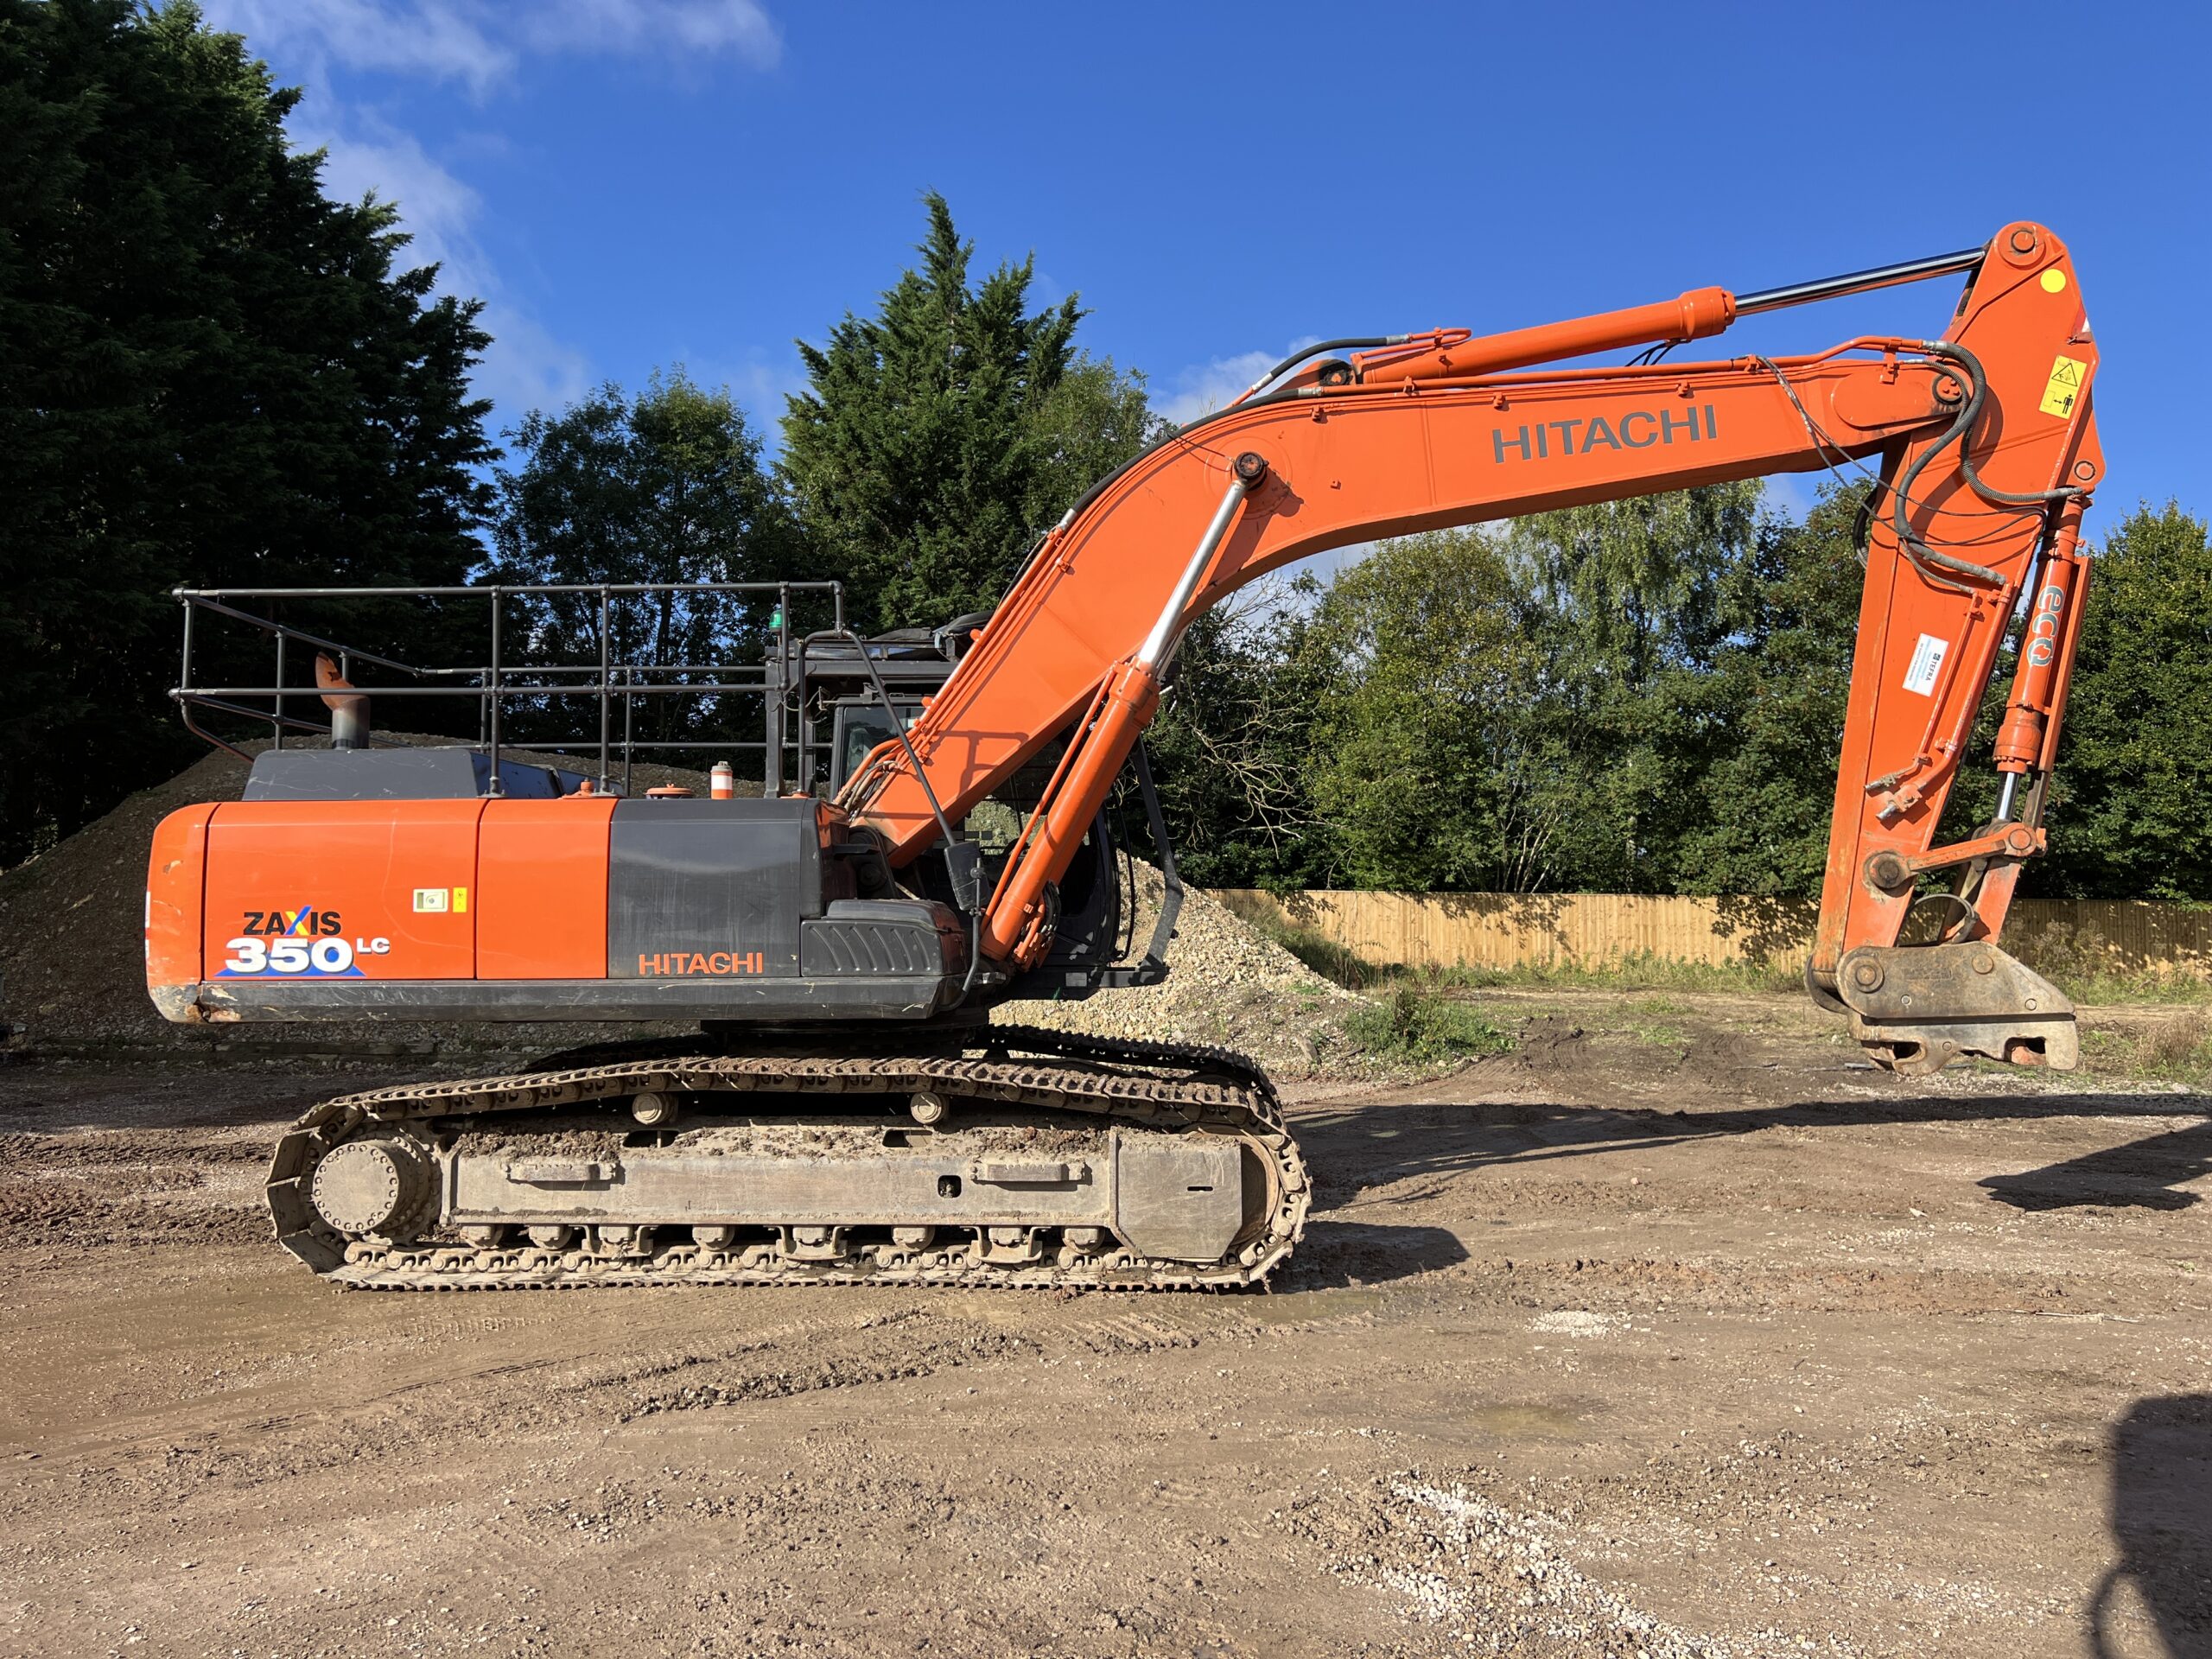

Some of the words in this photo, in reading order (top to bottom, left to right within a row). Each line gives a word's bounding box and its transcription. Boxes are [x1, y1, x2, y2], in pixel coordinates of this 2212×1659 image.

[1492, 404, 1717, 464] HITACHI
[243, 906, 341, 936] ZAXIS
[225, 938, 353, 973] 350
[356, 938, 390, 954] LC
[639, 952, 763, 975] HITACHI
